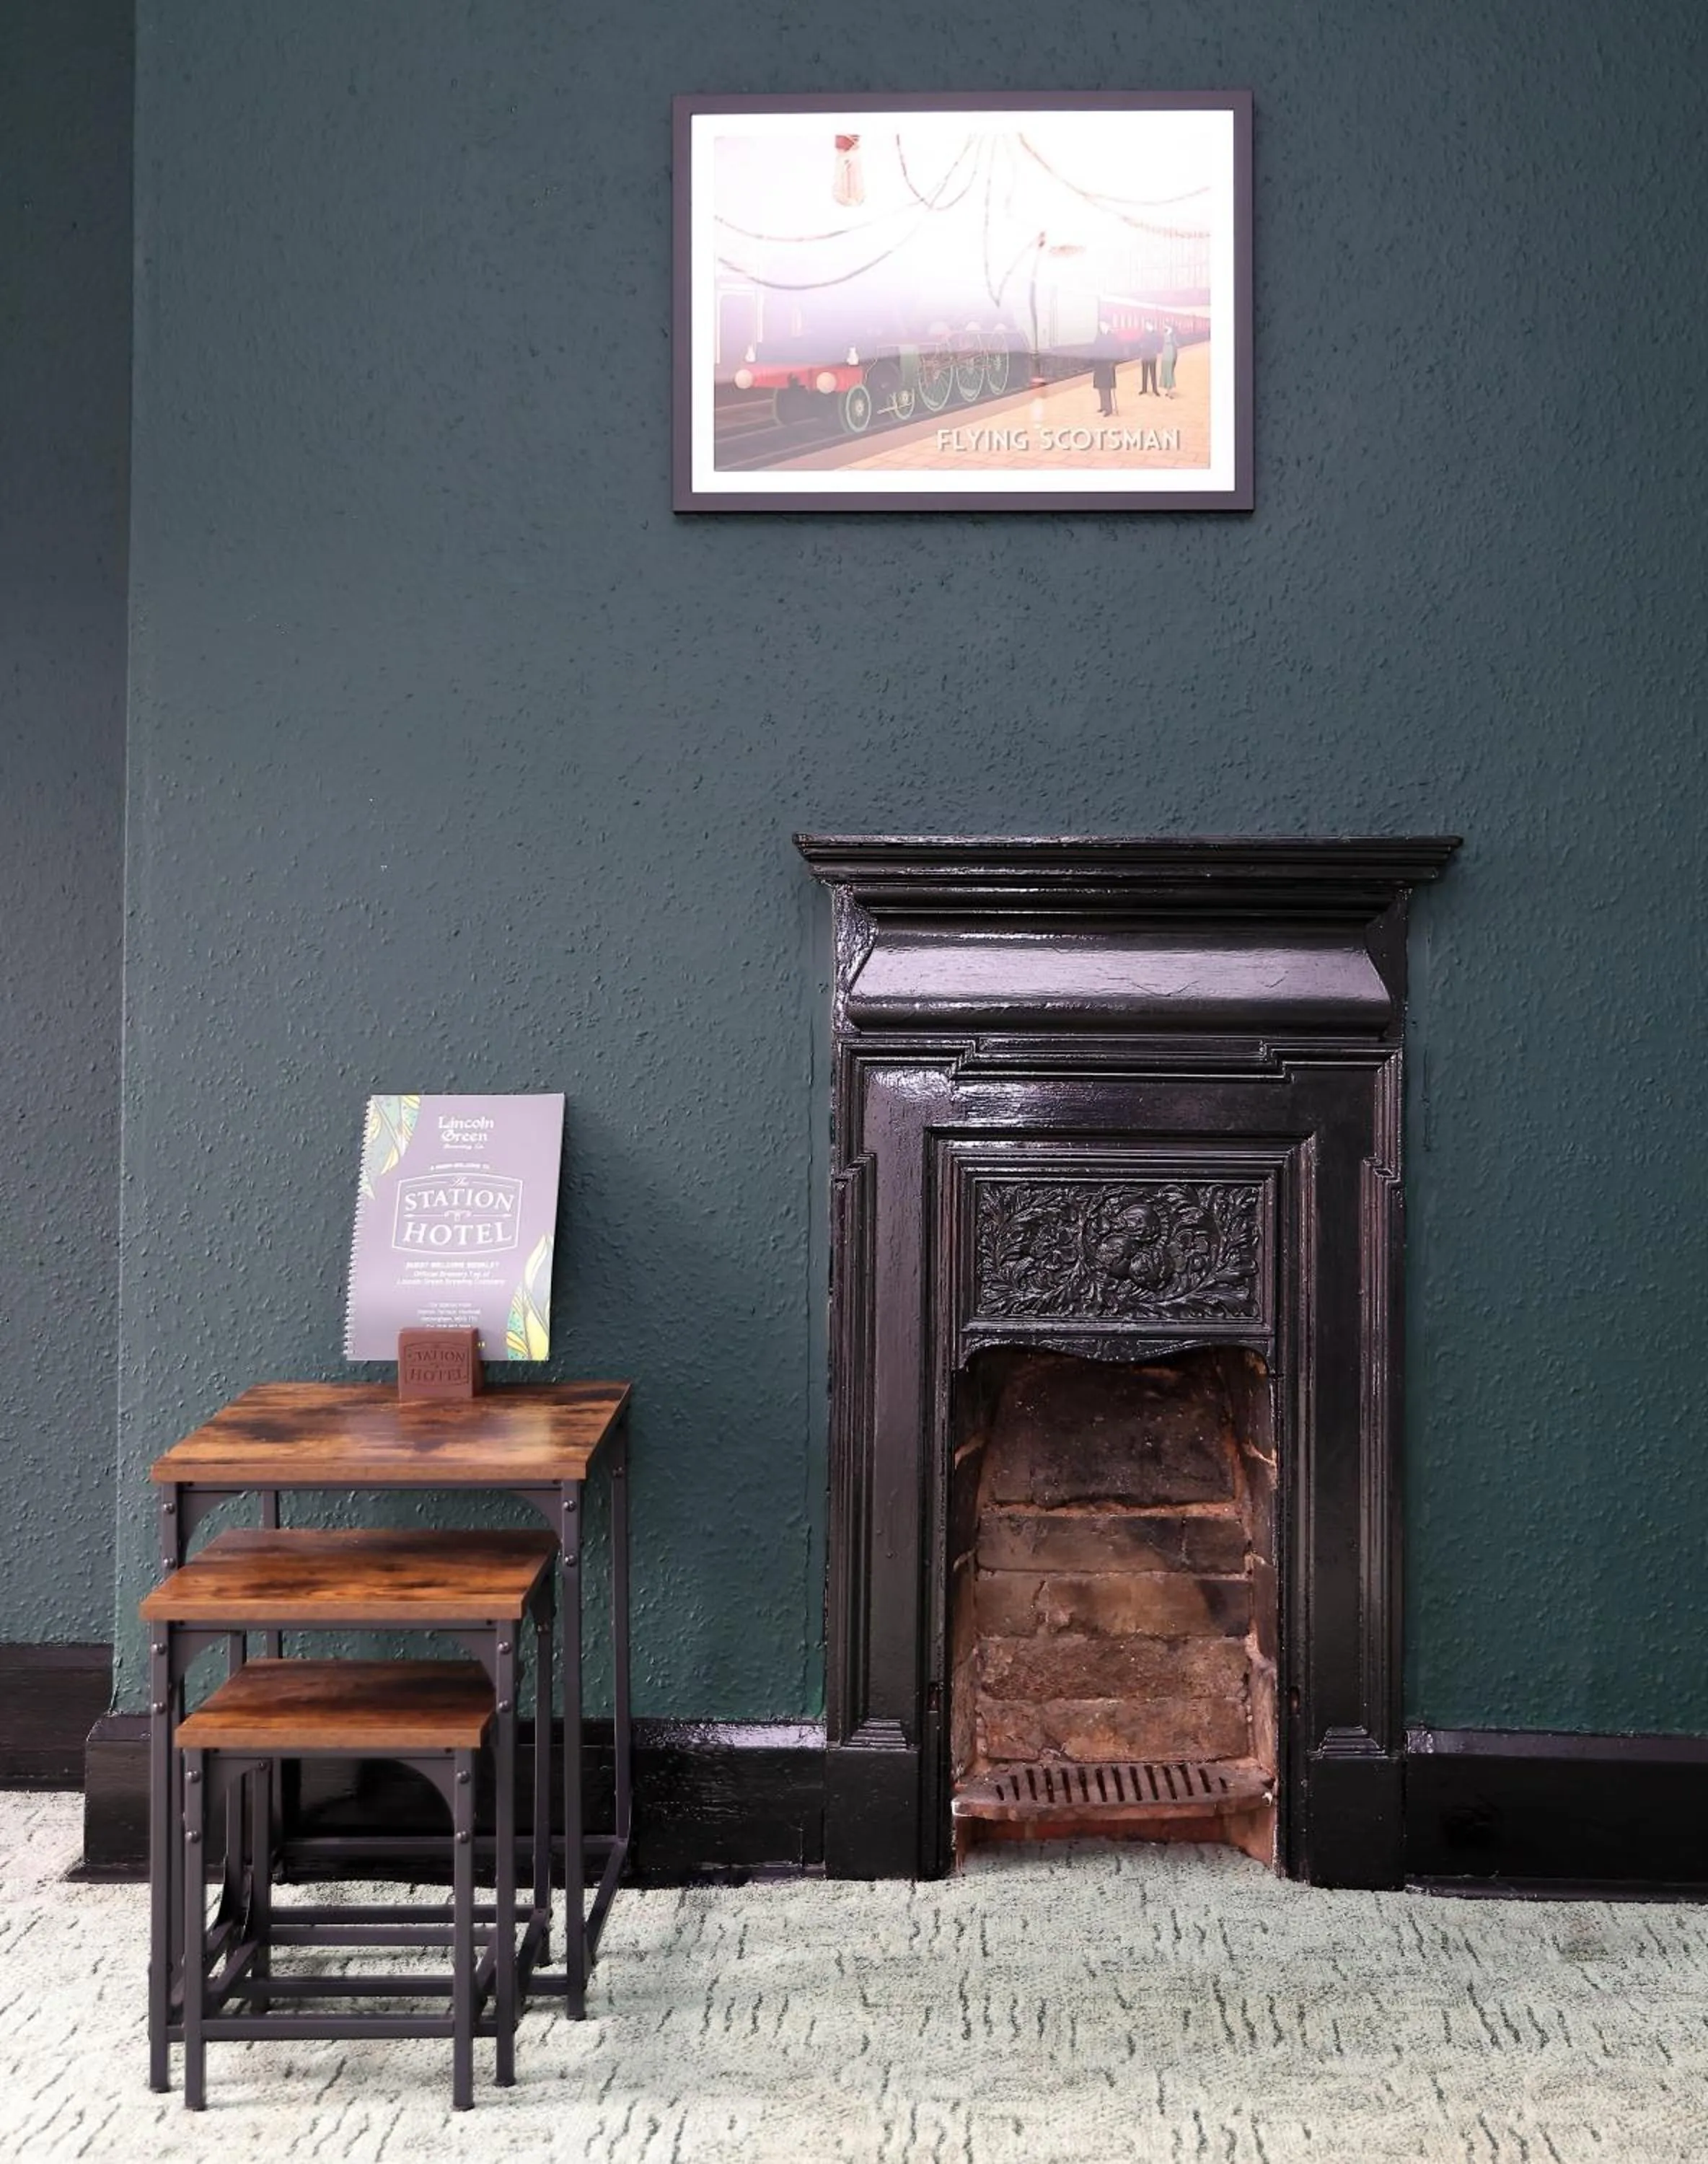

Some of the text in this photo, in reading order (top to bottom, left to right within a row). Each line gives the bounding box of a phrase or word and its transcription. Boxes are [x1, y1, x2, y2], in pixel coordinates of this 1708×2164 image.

[937, 428, 1181, 452] FLYING SCOTSMAN
[439, 1116, 494, 1129] Lincoln
[441, 1130, 488, 1142] Green
[405, 1189, 515, 1212] STATION
[403, 1222, 512, 1246] HOTEL
